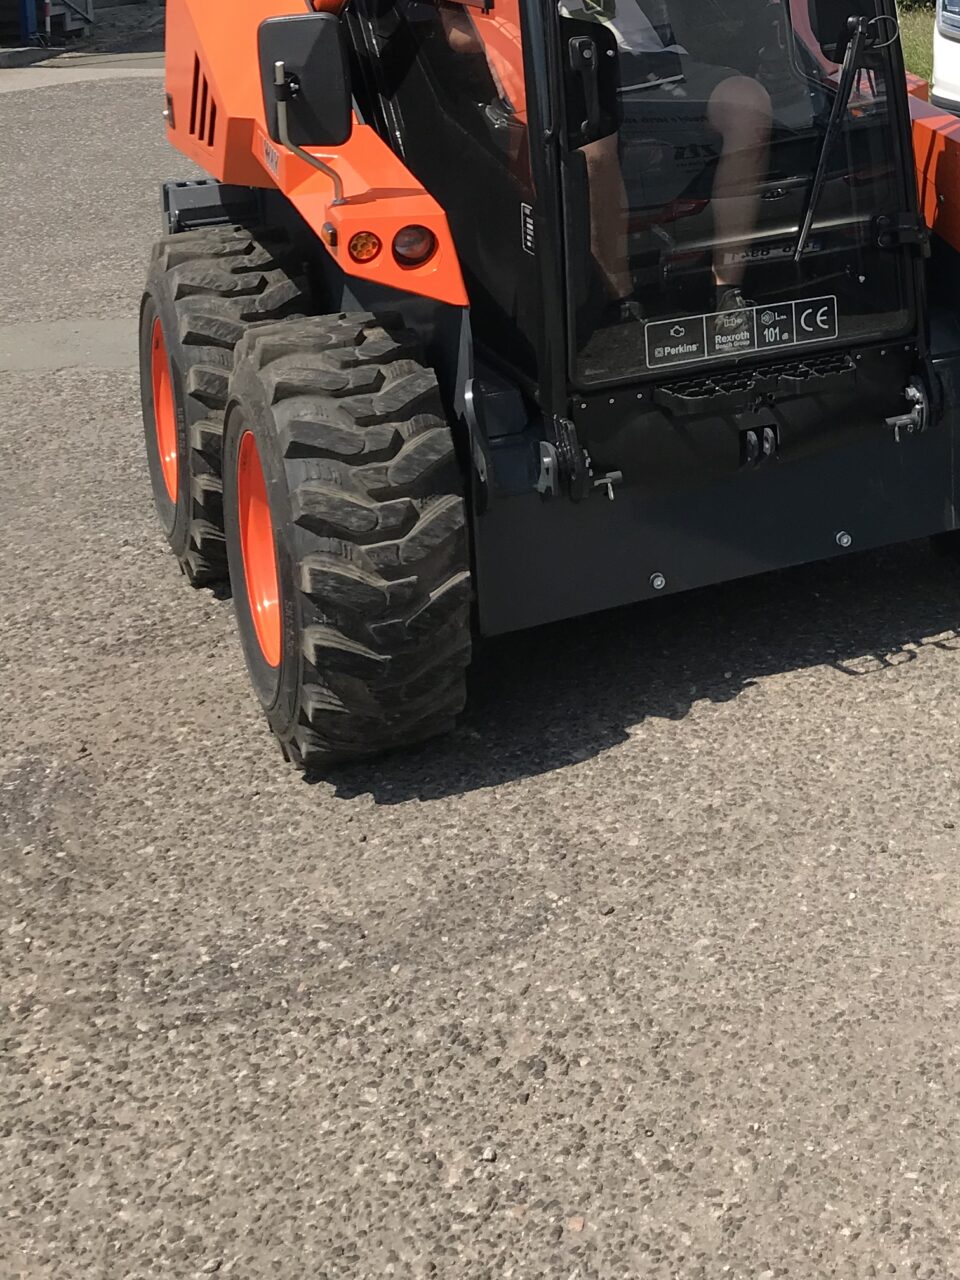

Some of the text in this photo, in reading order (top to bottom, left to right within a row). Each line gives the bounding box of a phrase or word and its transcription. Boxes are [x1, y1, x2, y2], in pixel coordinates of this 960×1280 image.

[800, 306, 830, 332] CE
[714, 331, 750, 344] Rexroth
[763, 326, 780, 342] 101
[664, 343, 698, 356] Perkins
